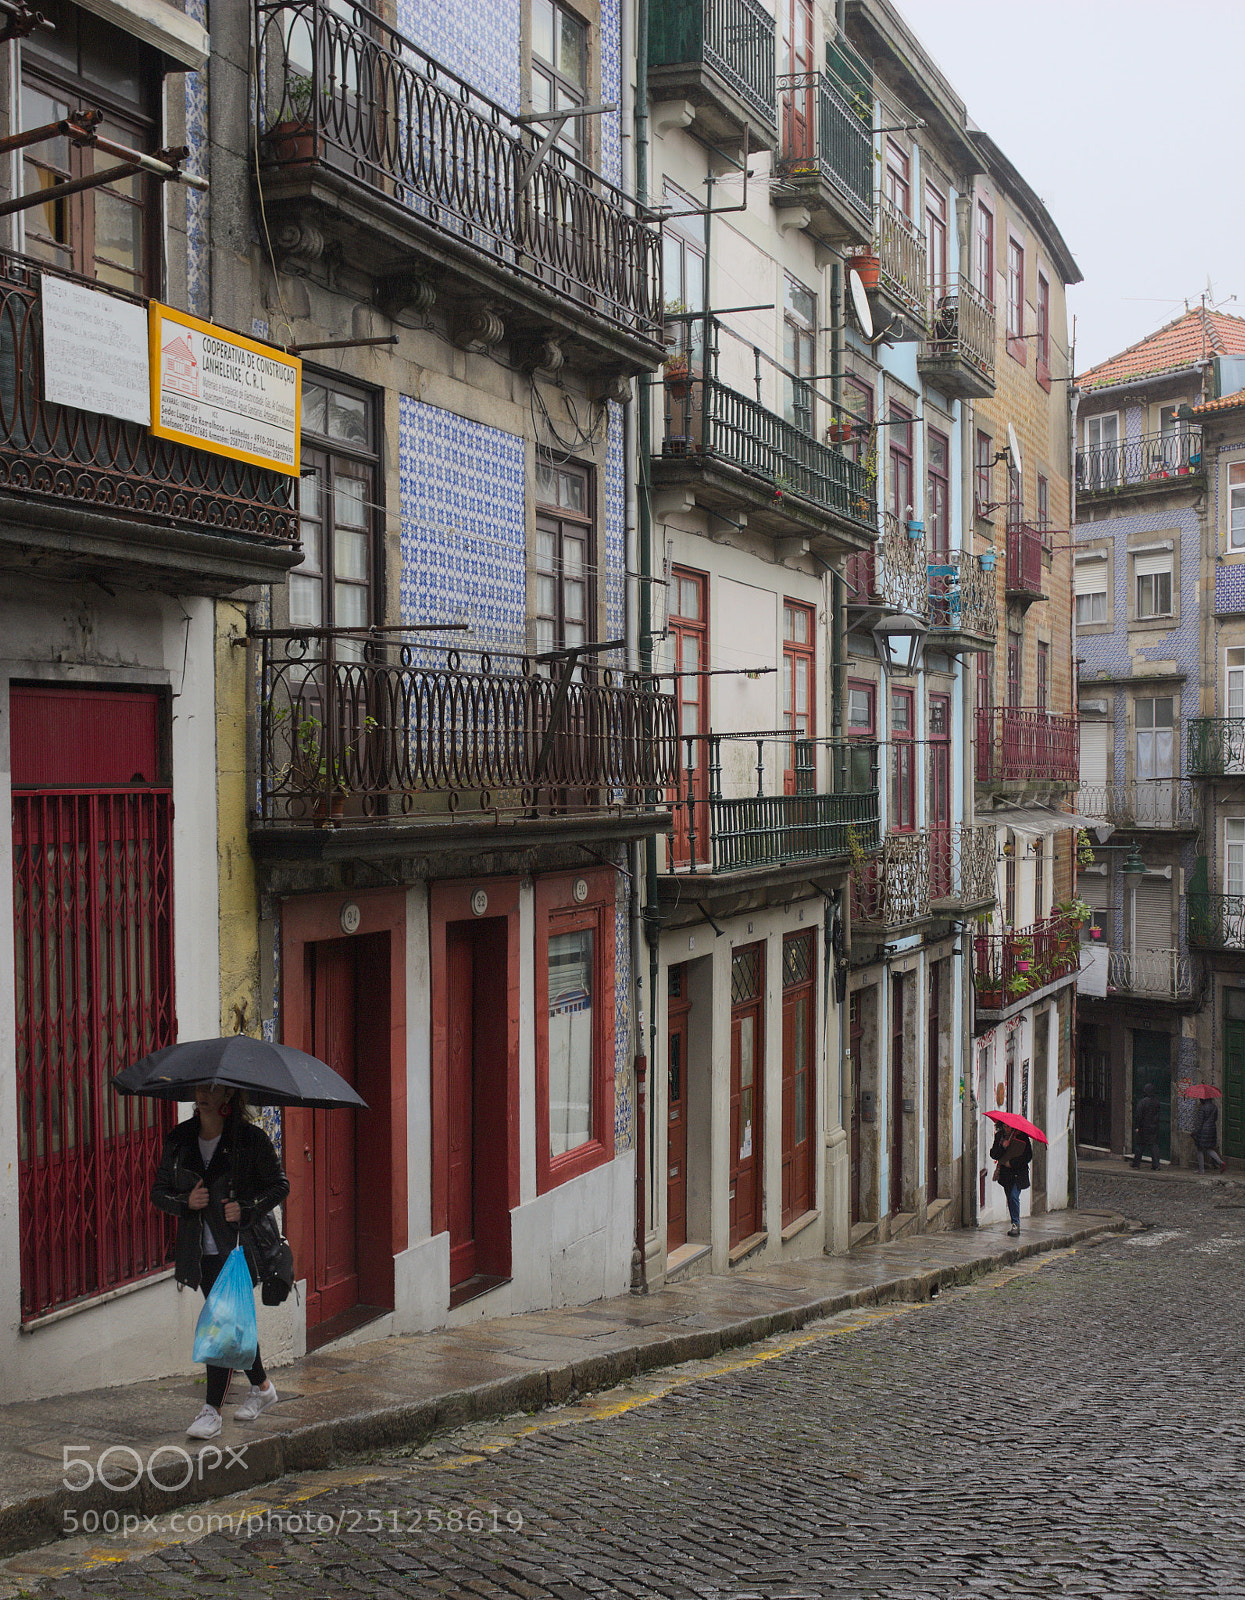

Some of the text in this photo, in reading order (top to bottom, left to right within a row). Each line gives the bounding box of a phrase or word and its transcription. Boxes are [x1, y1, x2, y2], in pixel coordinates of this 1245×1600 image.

[202, 337, 246, 366] COOPERATIVA
[246, 353, 255, 369] DE
[202, 356, 266, 391] LANHELENSE, C. R. L.
[161, 405, 176, 417] Sede:
[176, 409, 190, 424] Lugar
